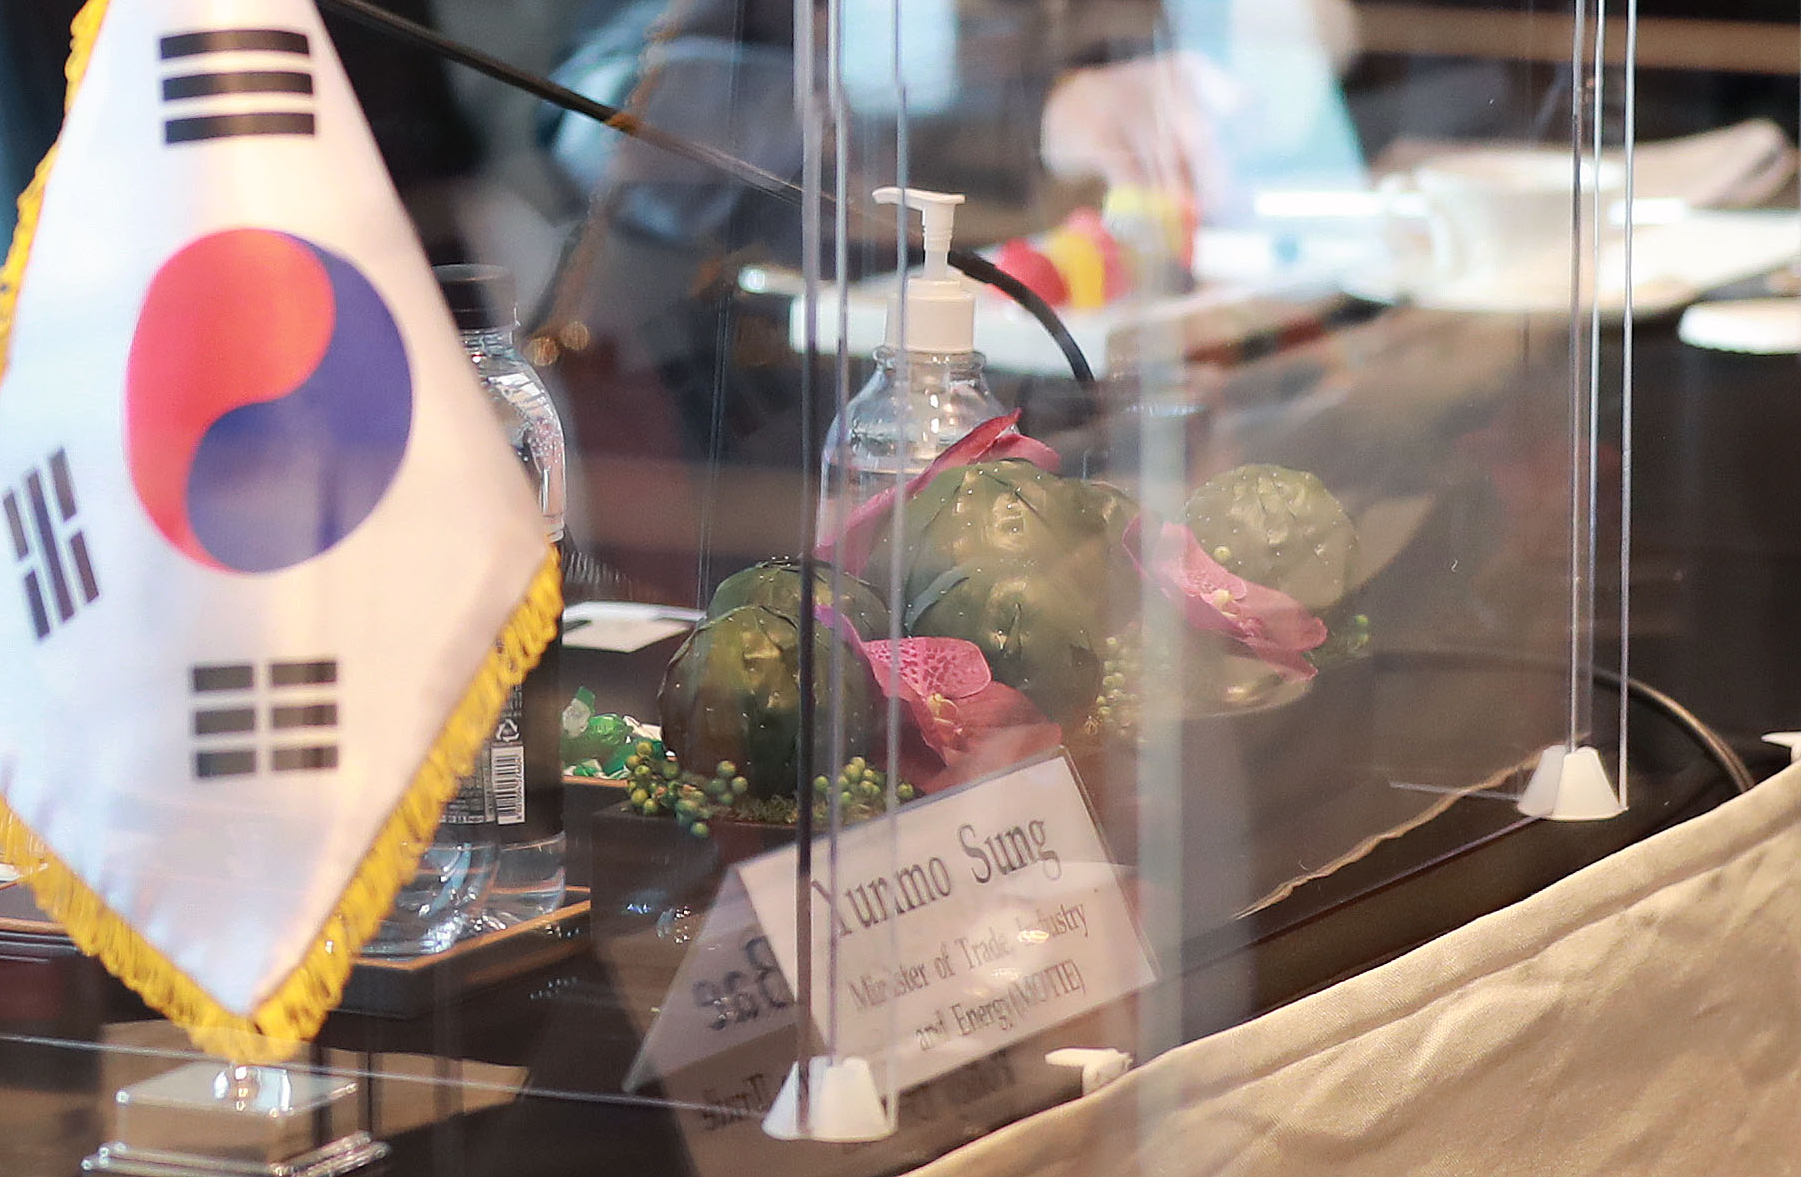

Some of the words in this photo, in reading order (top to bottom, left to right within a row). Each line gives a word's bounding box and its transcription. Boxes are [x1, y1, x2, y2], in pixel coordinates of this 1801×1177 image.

[957, 819, 1063, 885] Sung
[849, 960, 930, 1013] Minster
[933, 941, 956, 980] of
